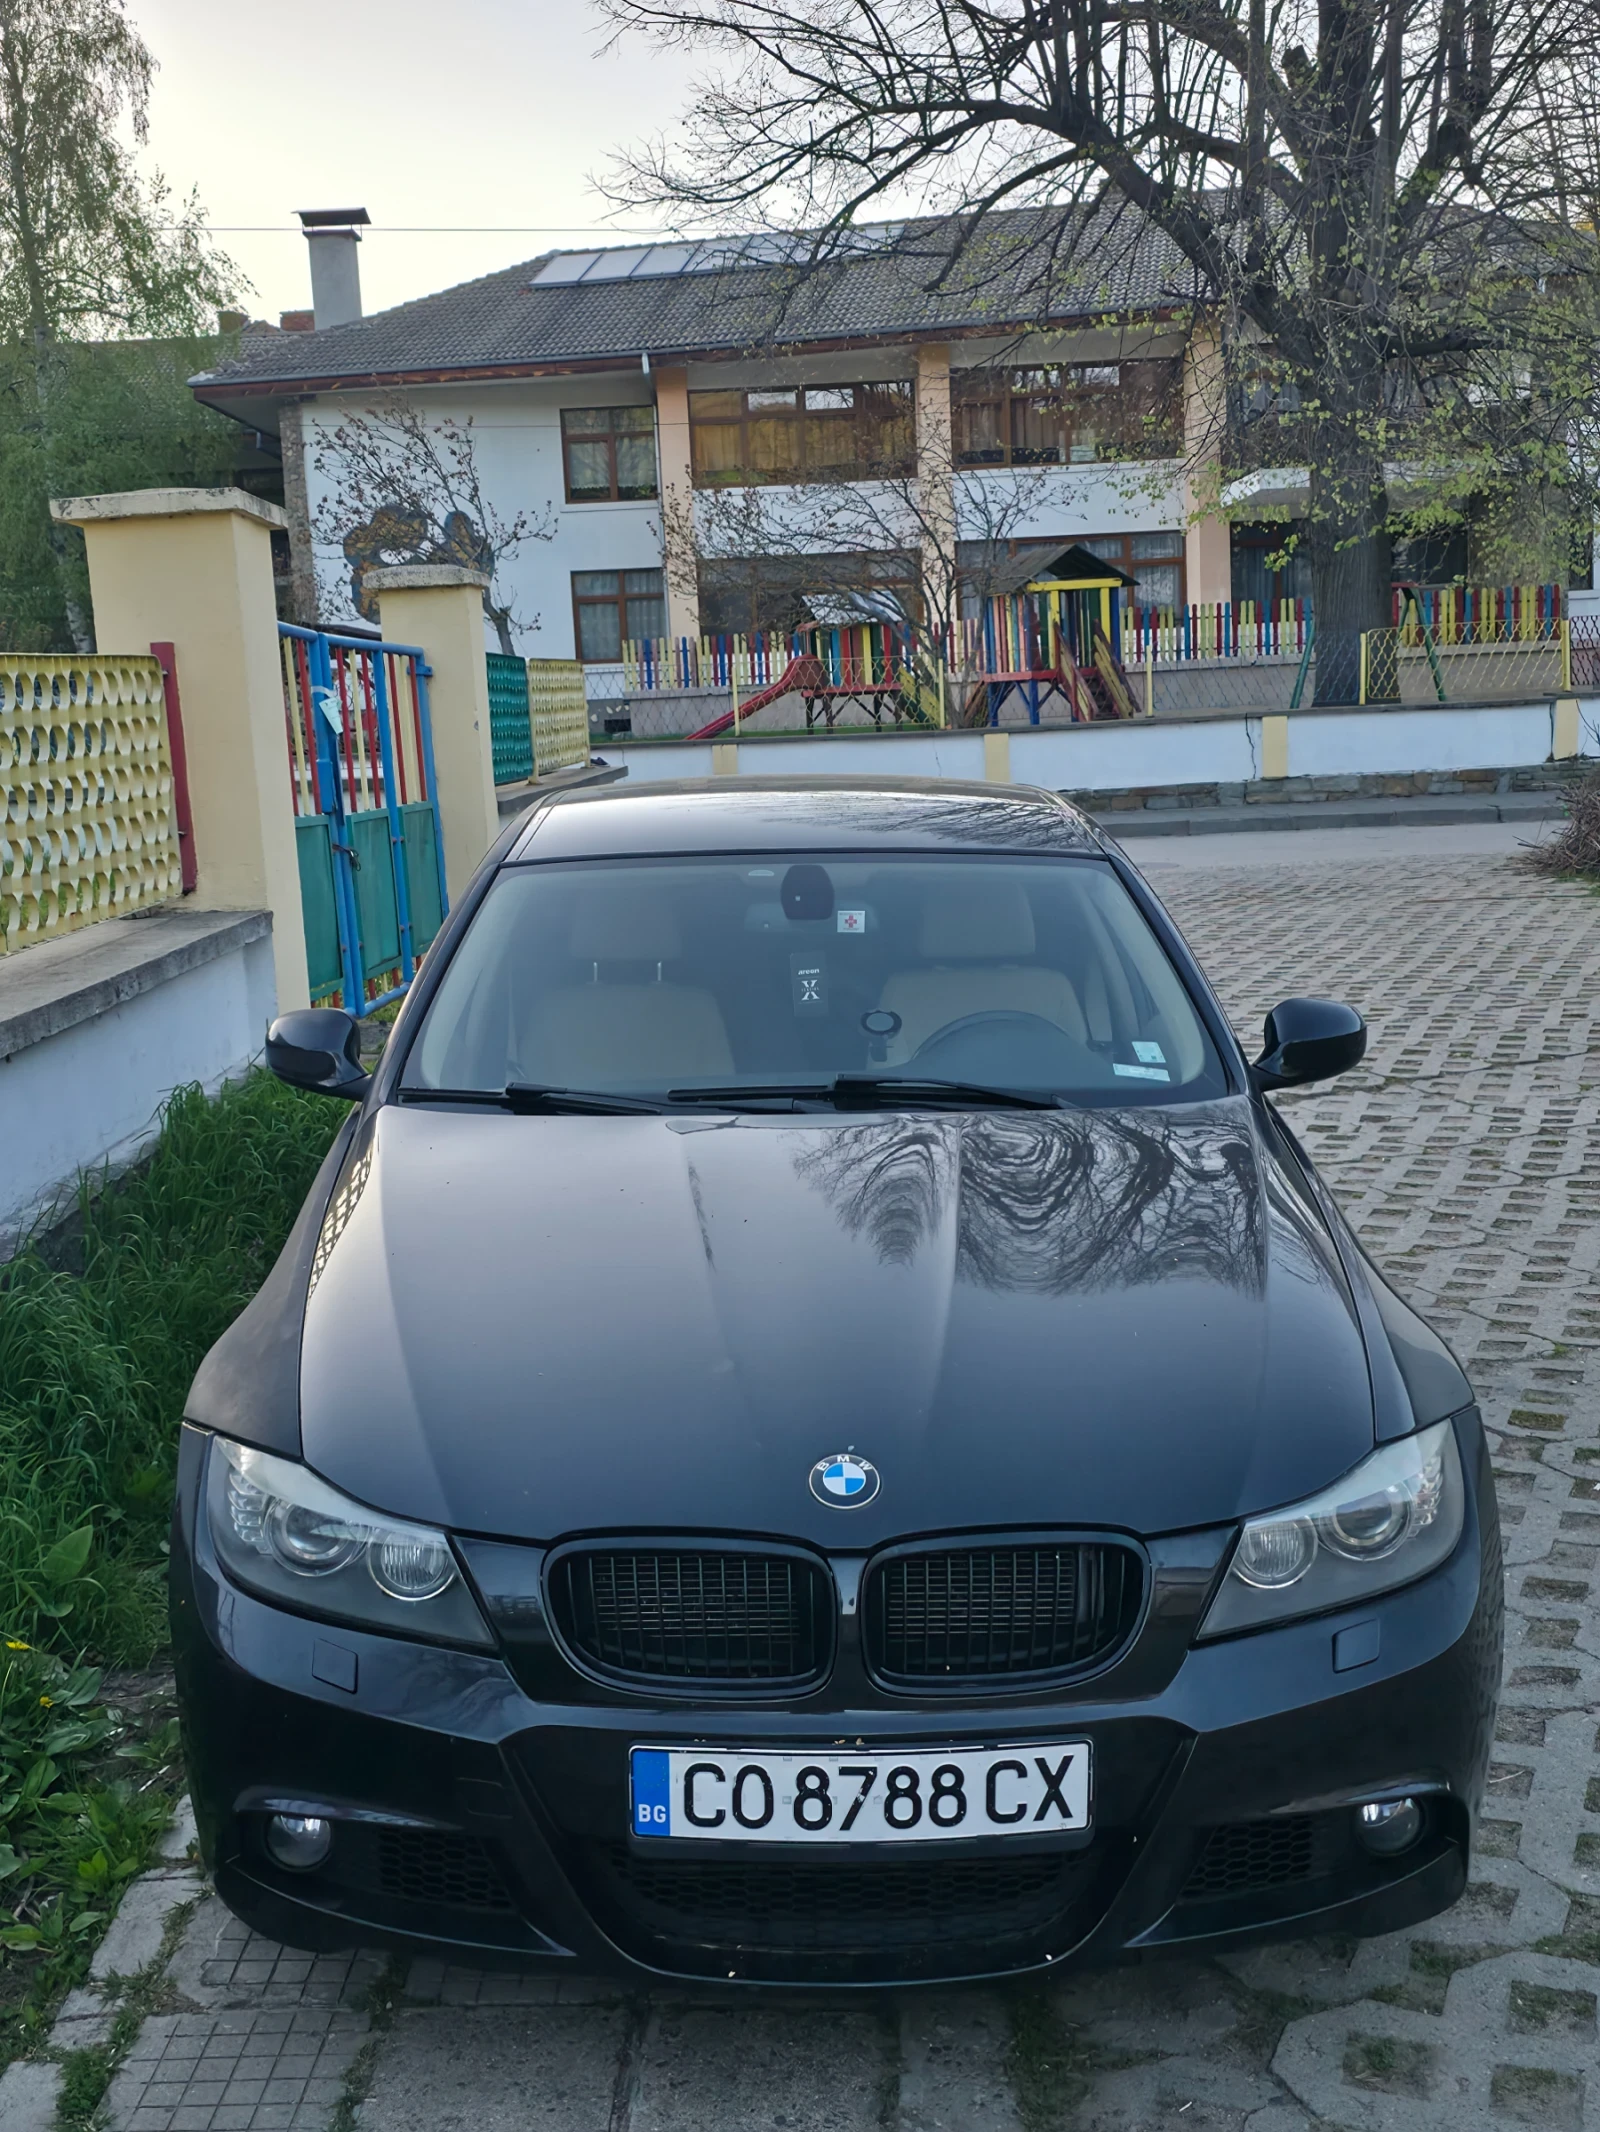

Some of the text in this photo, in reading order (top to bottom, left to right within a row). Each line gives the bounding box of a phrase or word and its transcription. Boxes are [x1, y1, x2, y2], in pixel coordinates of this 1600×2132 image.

[816, 1454, 873, 1471] BMW
[683, 1754, 1076, 1832] CO 8788 CX
[638, 1803, 667, 1824] BG
